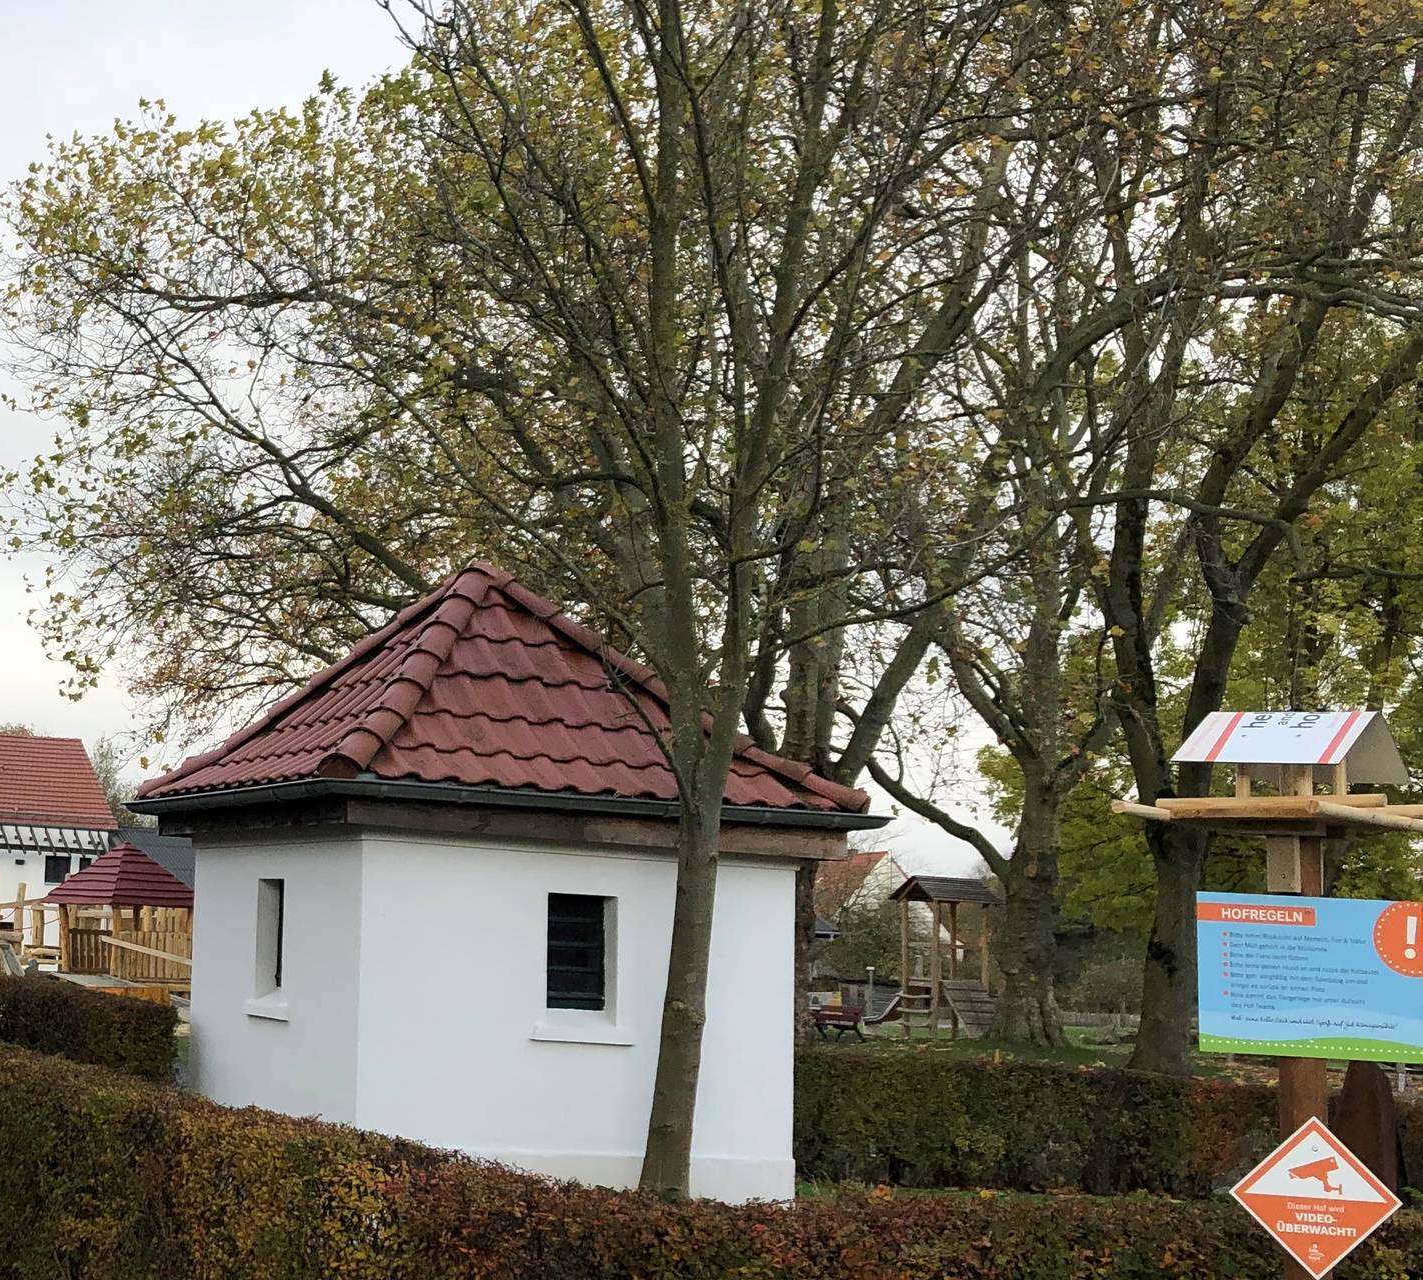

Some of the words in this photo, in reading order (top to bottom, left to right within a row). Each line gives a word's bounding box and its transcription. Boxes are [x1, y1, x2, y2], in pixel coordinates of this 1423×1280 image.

[1288, 712, 1322, 729] ho
[1221, 907, 1303, 922] HOFREGELN
[1287, 1201, 1312, 1211] Dieser
[1313, 1204, 1327, 1212] Hof
[1328, 1205, 1345, 1213] wird
[1276, 1220, 1357, 1238] ÜBERWACHT!
